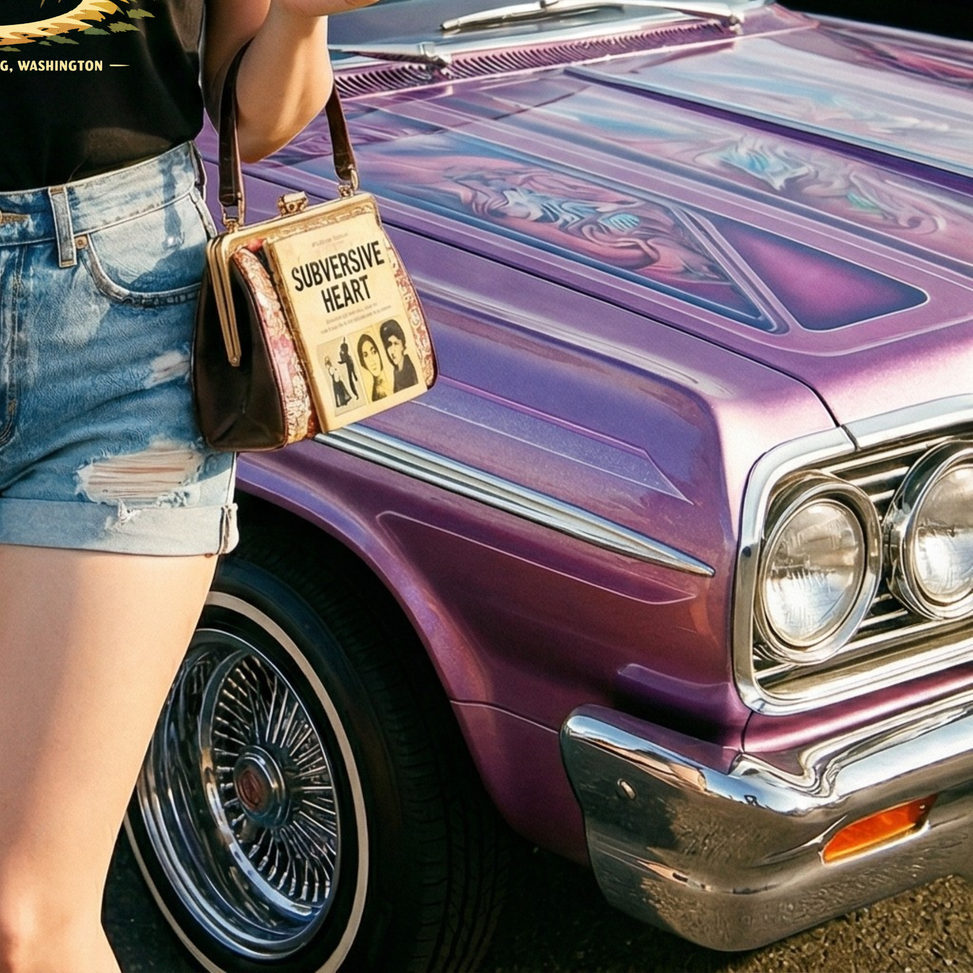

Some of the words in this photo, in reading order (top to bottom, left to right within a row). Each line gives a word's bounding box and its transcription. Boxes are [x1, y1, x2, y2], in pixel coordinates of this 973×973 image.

[17, 60, 104, 72] WASHINGTON
[291, 240, 385, 292] SUBVERSIVE
[321, 274, 371, 313] HEART
